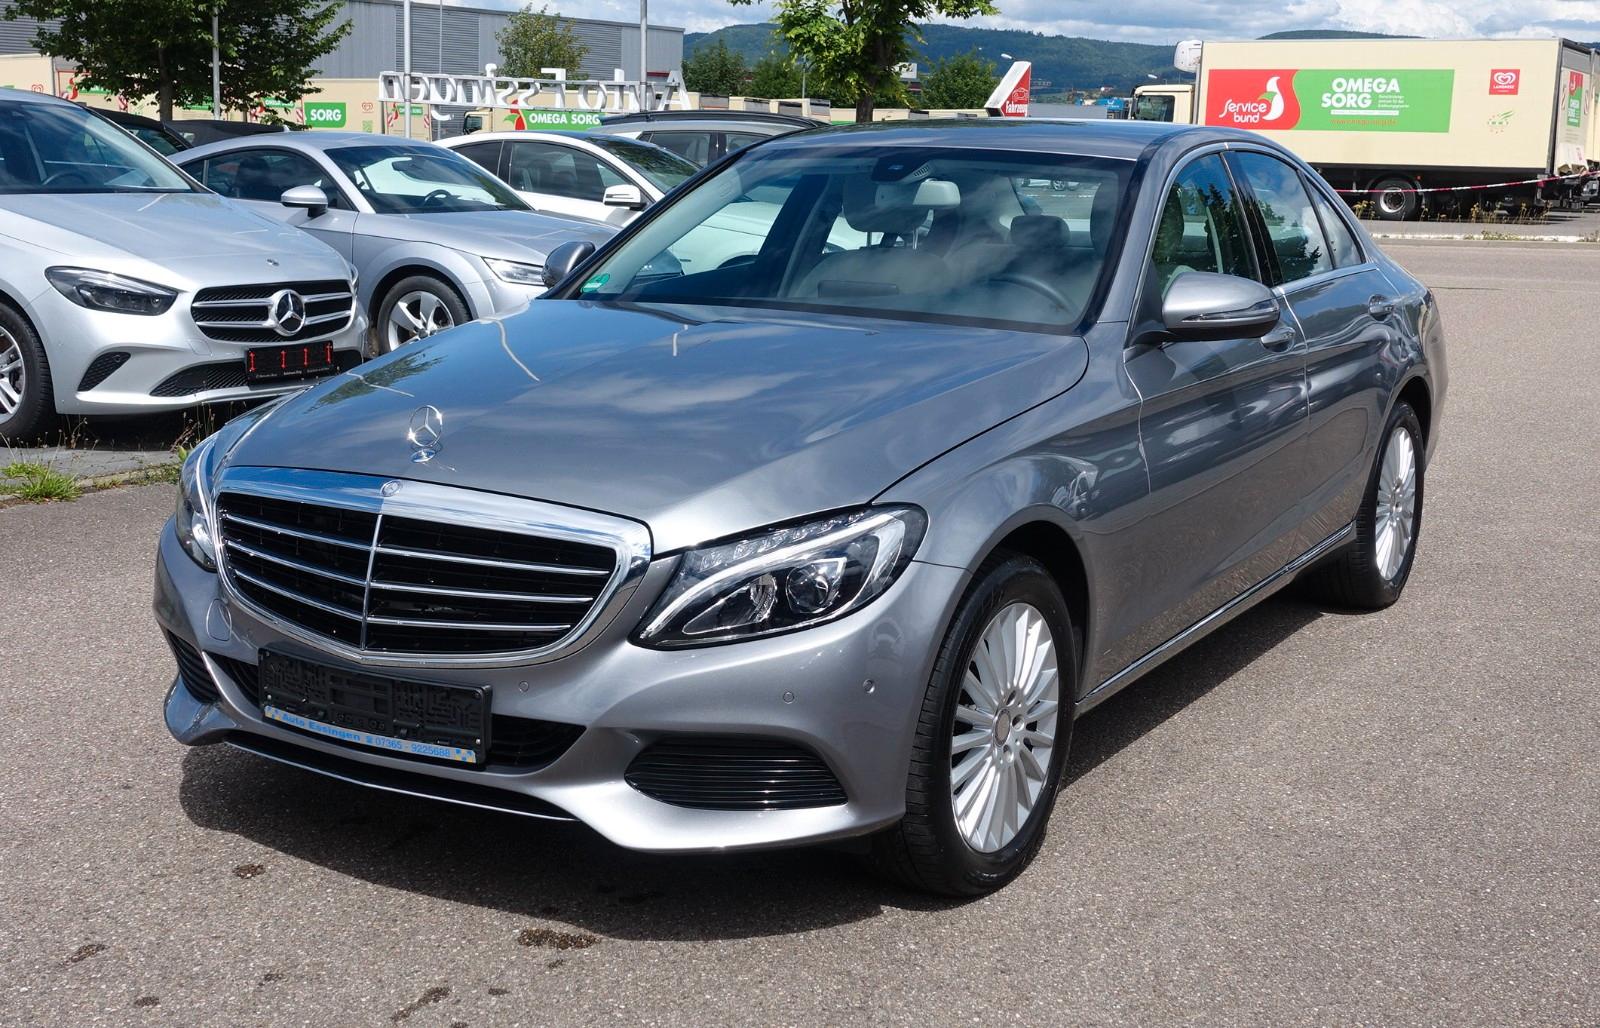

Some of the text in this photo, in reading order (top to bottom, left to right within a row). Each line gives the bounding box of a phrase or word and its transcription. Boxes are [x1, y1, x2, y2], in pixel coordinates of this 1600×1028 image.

[1331, 77, 1400, 93] OMEGA
[1321, 93, 1372, 108] SORG
[310, 108, 342, 121] SORG
[528, 112, 600, 126] OMEGA SORG
[1233, 112, 1260, 123] bund
[282, 712, 305, 727] Auto
[308, 720, 361, 742] Essingen
[375, 736, 403, 751] 07365
